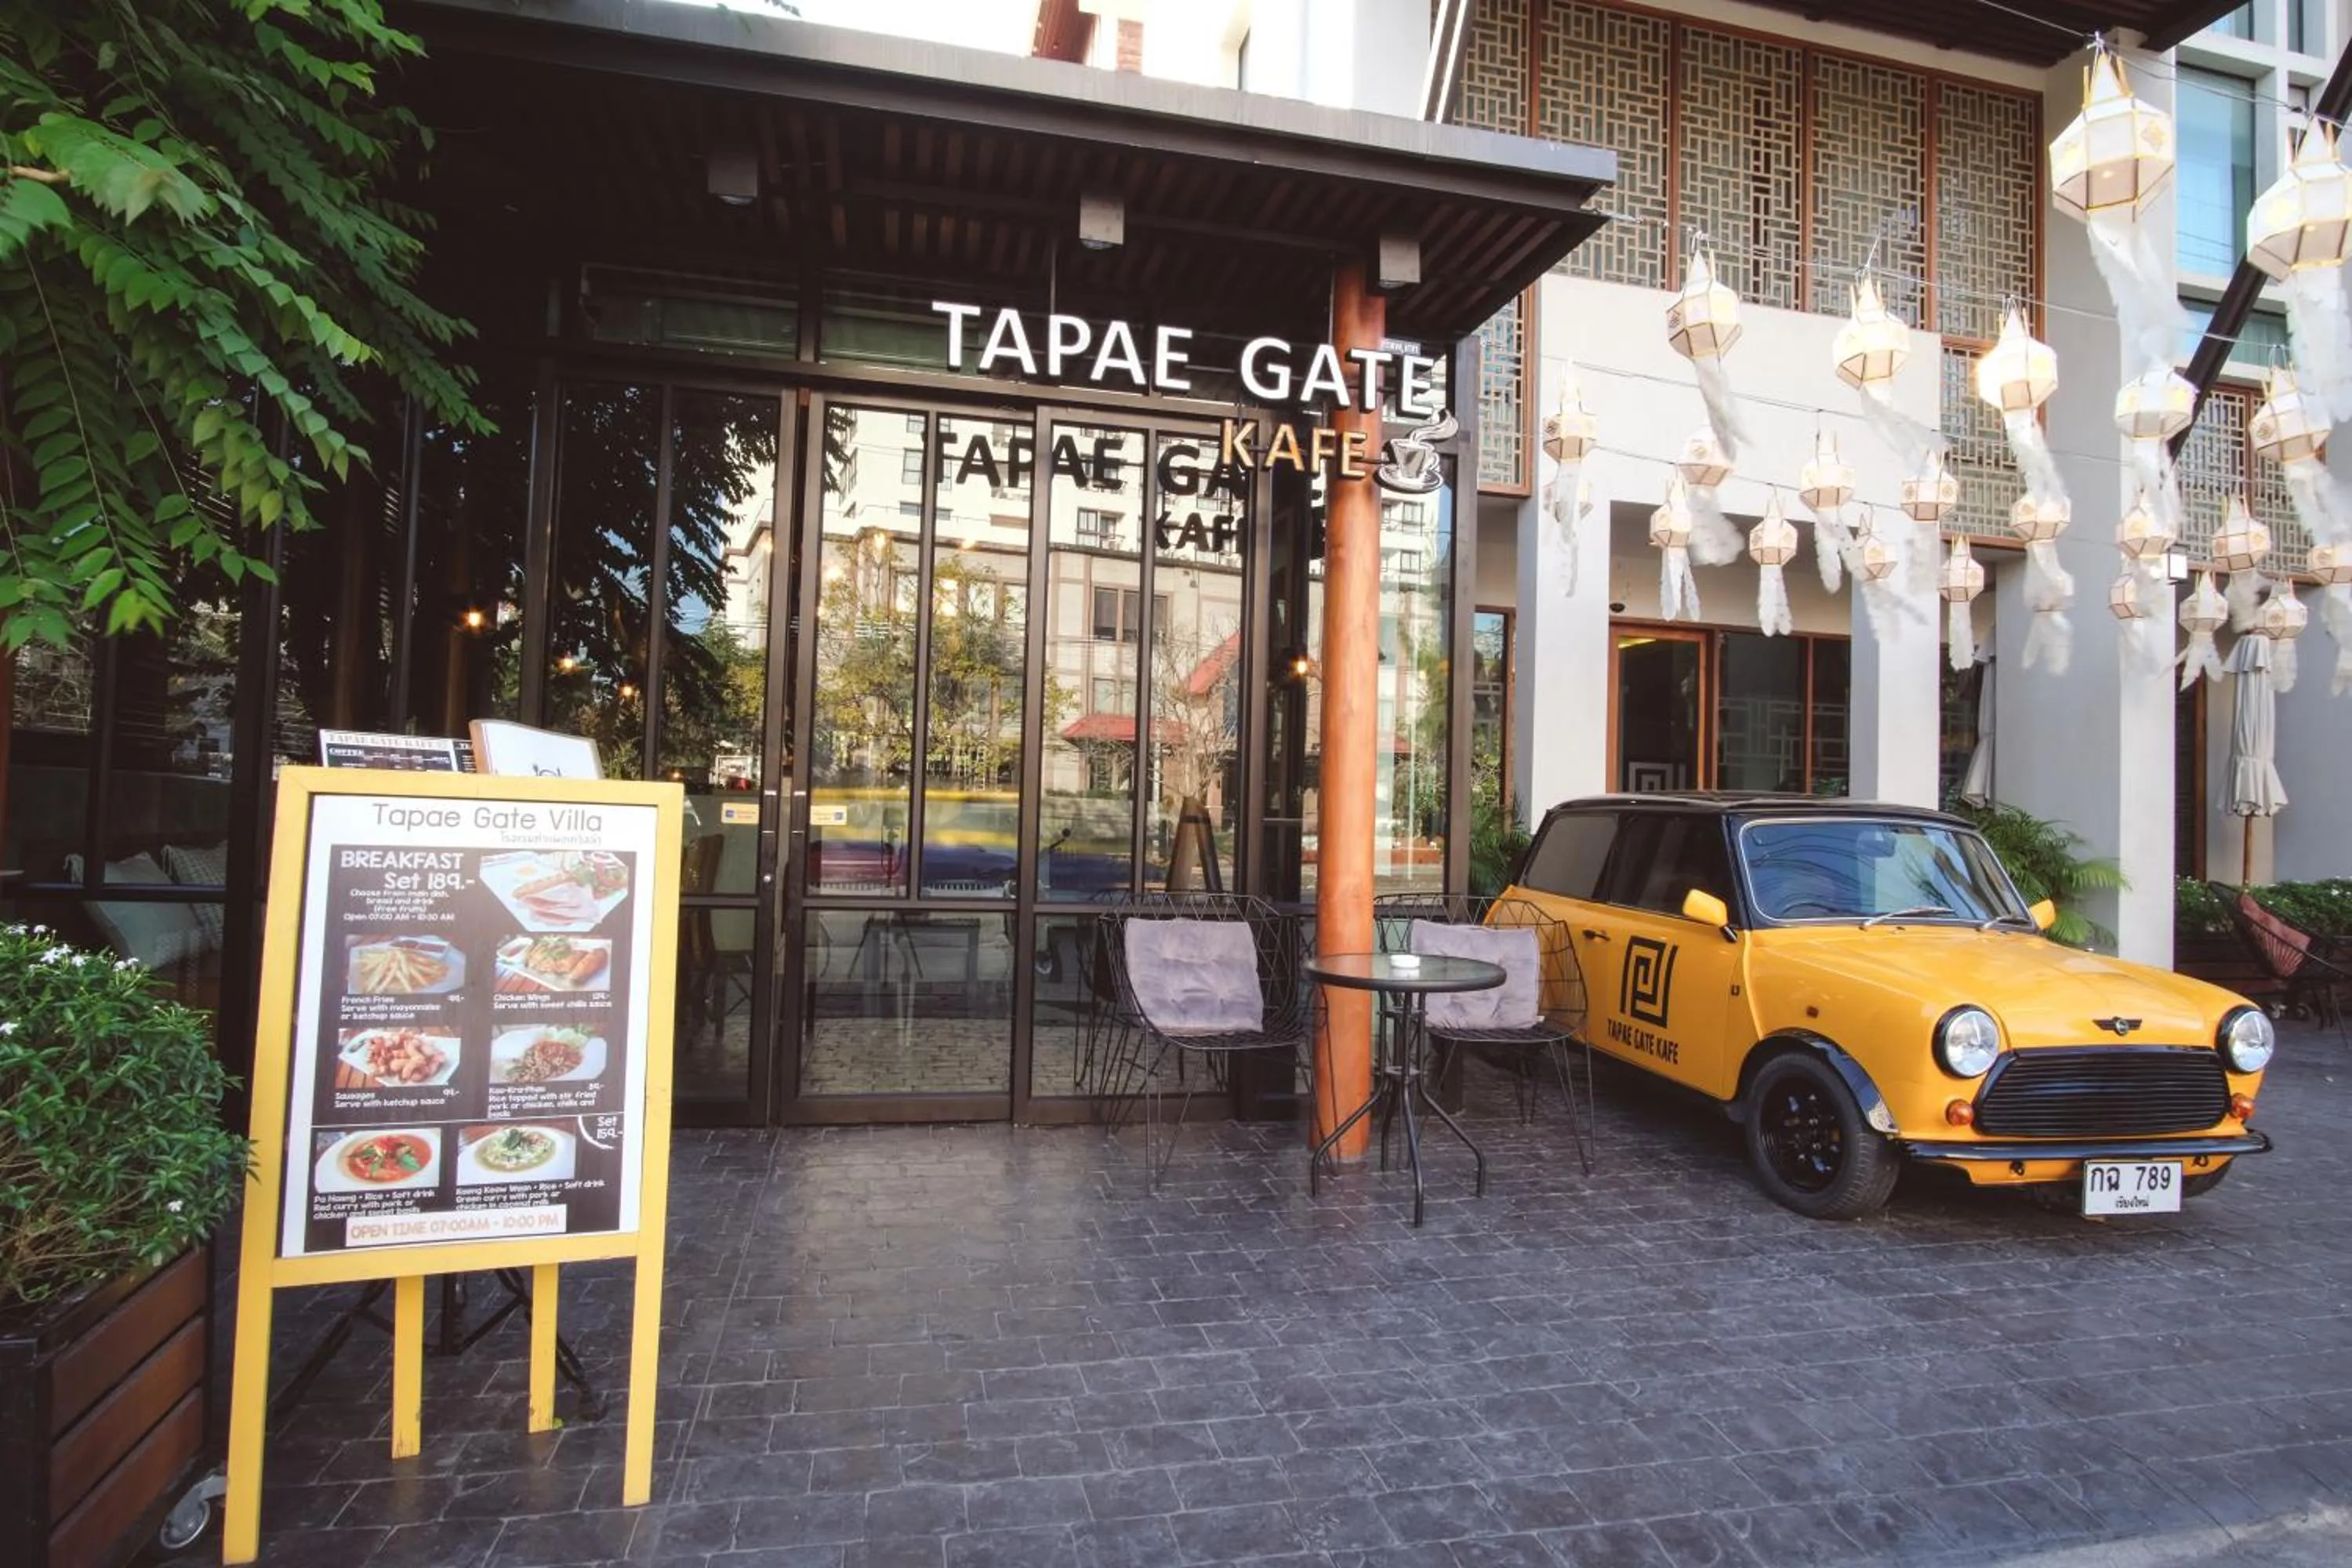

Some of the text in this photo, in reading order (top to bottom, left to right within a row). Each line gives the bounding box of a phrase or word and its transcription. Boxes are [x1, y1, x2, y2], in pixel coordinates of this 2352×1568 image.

[932, 300, 1436, 417] TAPAE GATE
[1221, 418, 1369, 481] KAFE
[372, 803, 602, 833] Tapae Gate Villa
[340, 851, 464, 869] BREAKFAST
[384, 872, 475, 891] Set 189.-
[341, 996, 372, 1004] French
[372, 996, 395, 1004] Fries
[493, 993, 525, 1002] Chicken
[1608, 1019, 1679, 1065] TAPAE GATE KAFE
[334, 1100, 361, 1109] Serve
[383, 1098, 418, 1108] ketchup
[509, 1094, 538, 1103] topped
[540, 1092, 557, 1101] with
[488, 1102, 507, 1111] pork
[597, 1116, 617, 1127] Set
[2135, 1166, 2172, 1191] 789
[365, 1192, 383, 1201] Rice
[392, 1191, 411, 1200] Soft
[413, 1189, 435, 1198] drink
[484, 1194, 507, 1203] curry
[529, 1191, 549, 1200] pork
[333, 1202, 358, 1211] curry
[361, 1200, 381, 1209] with
[382, 1200, 402, 1209] pork
[314, 1211, 347, 1220] chicken
[350, 1223, 388, 1240] OPEN
[391, 1221, 428, 1237] TIME
[538, 1214, 559, 1228] PM
